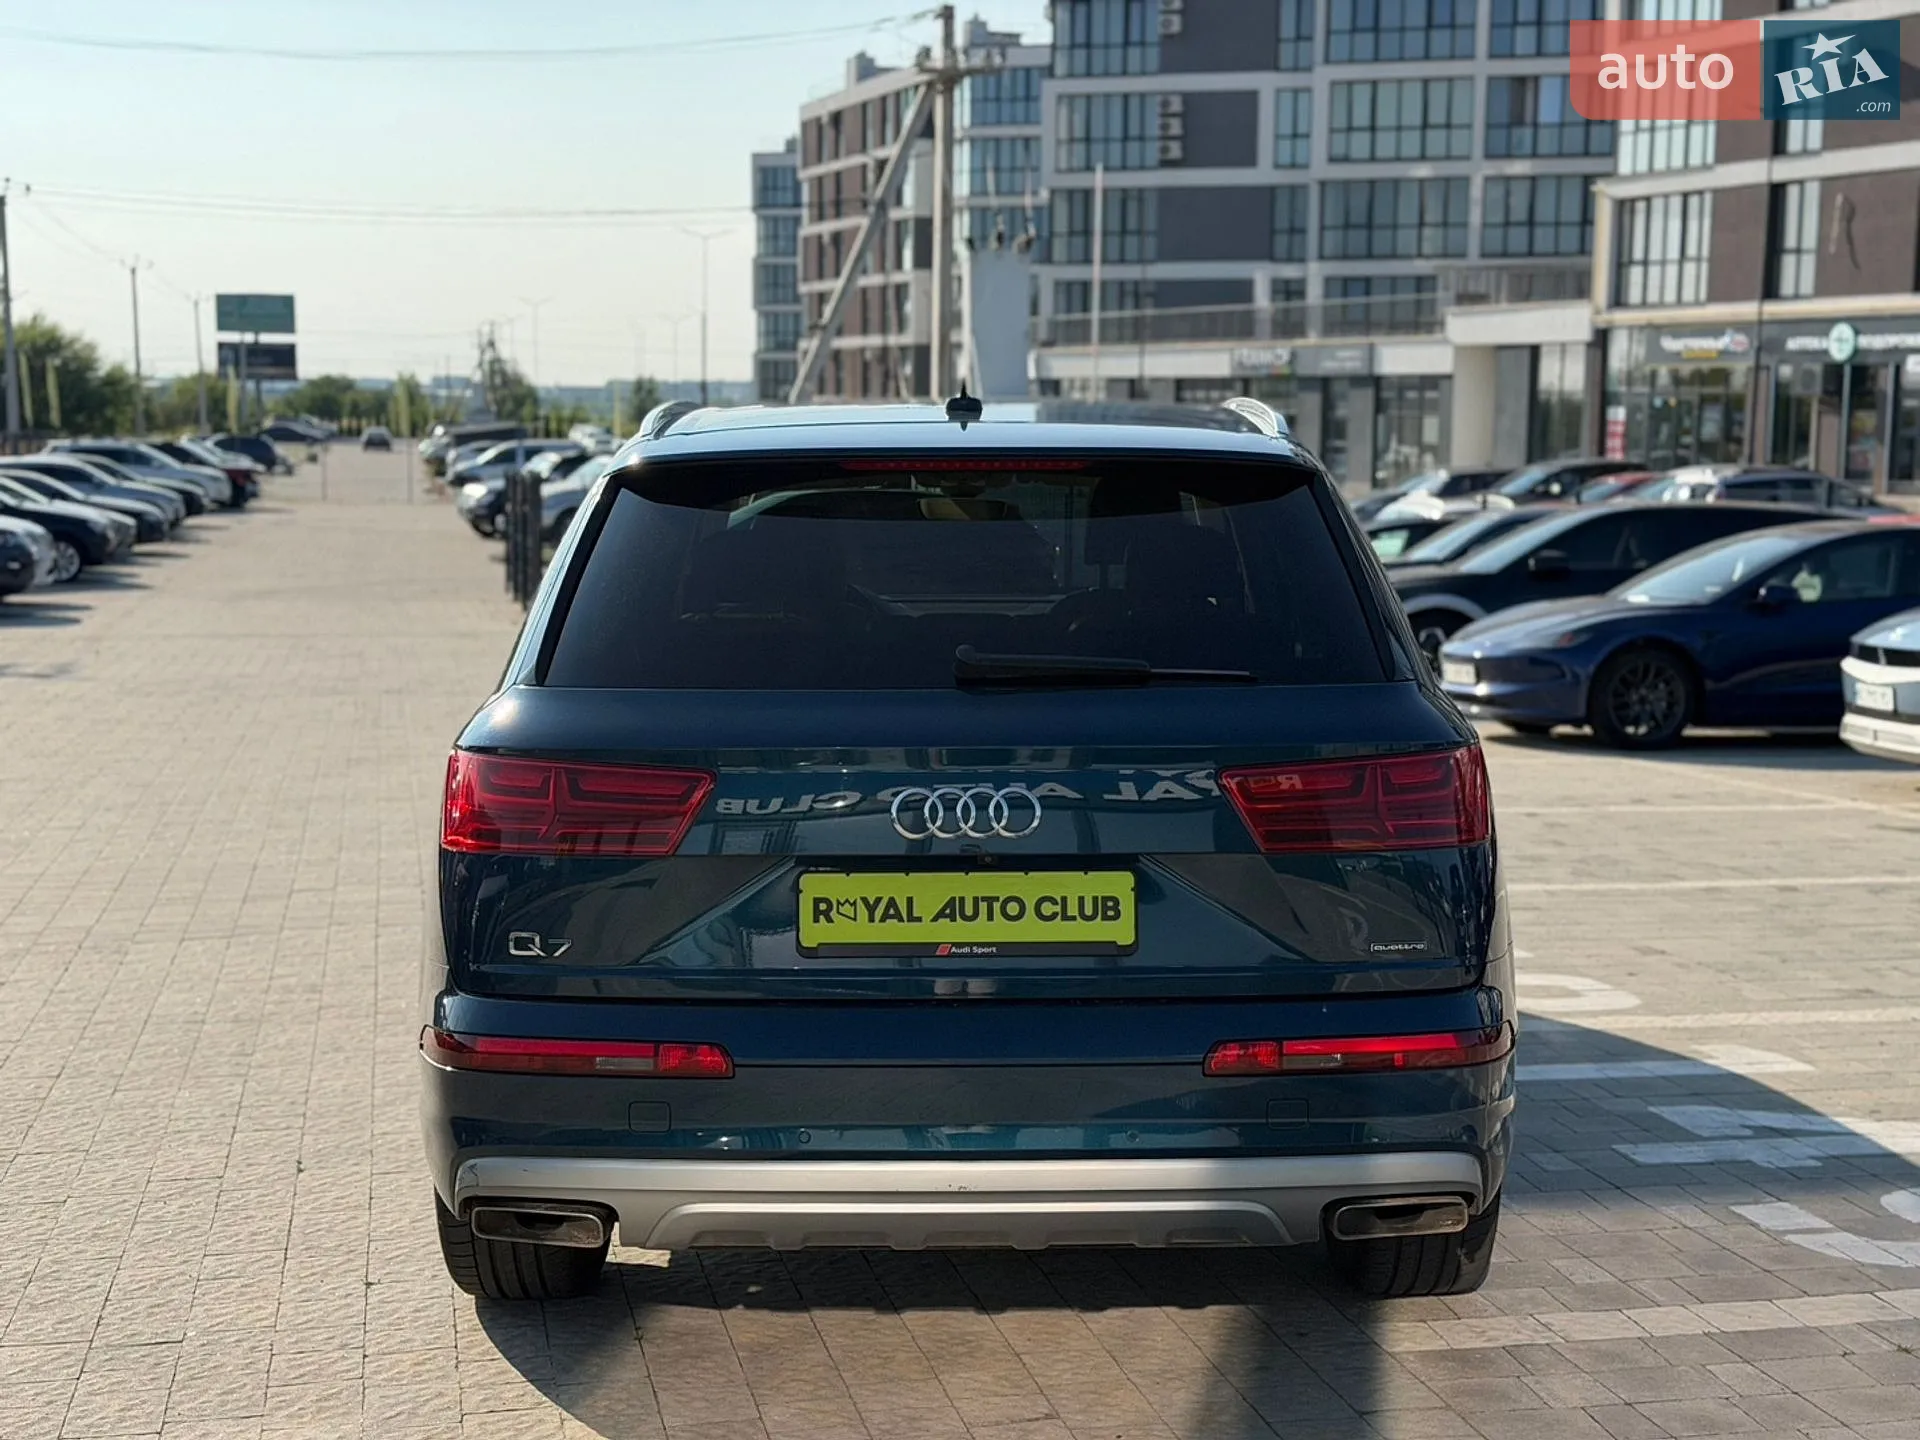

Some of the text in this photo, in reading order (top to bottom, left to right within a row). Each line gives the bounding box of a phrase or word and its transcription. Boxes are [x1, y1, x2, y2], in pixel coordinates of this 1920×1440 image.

[930, 895, 1027, 923] AUTO
[1034, 895, 1122, 922] CLUB
[508, 931, 572, 957] Q7
[972, 946, 997, 954] Sport
[1373, 943, 1425, 951] quattro
